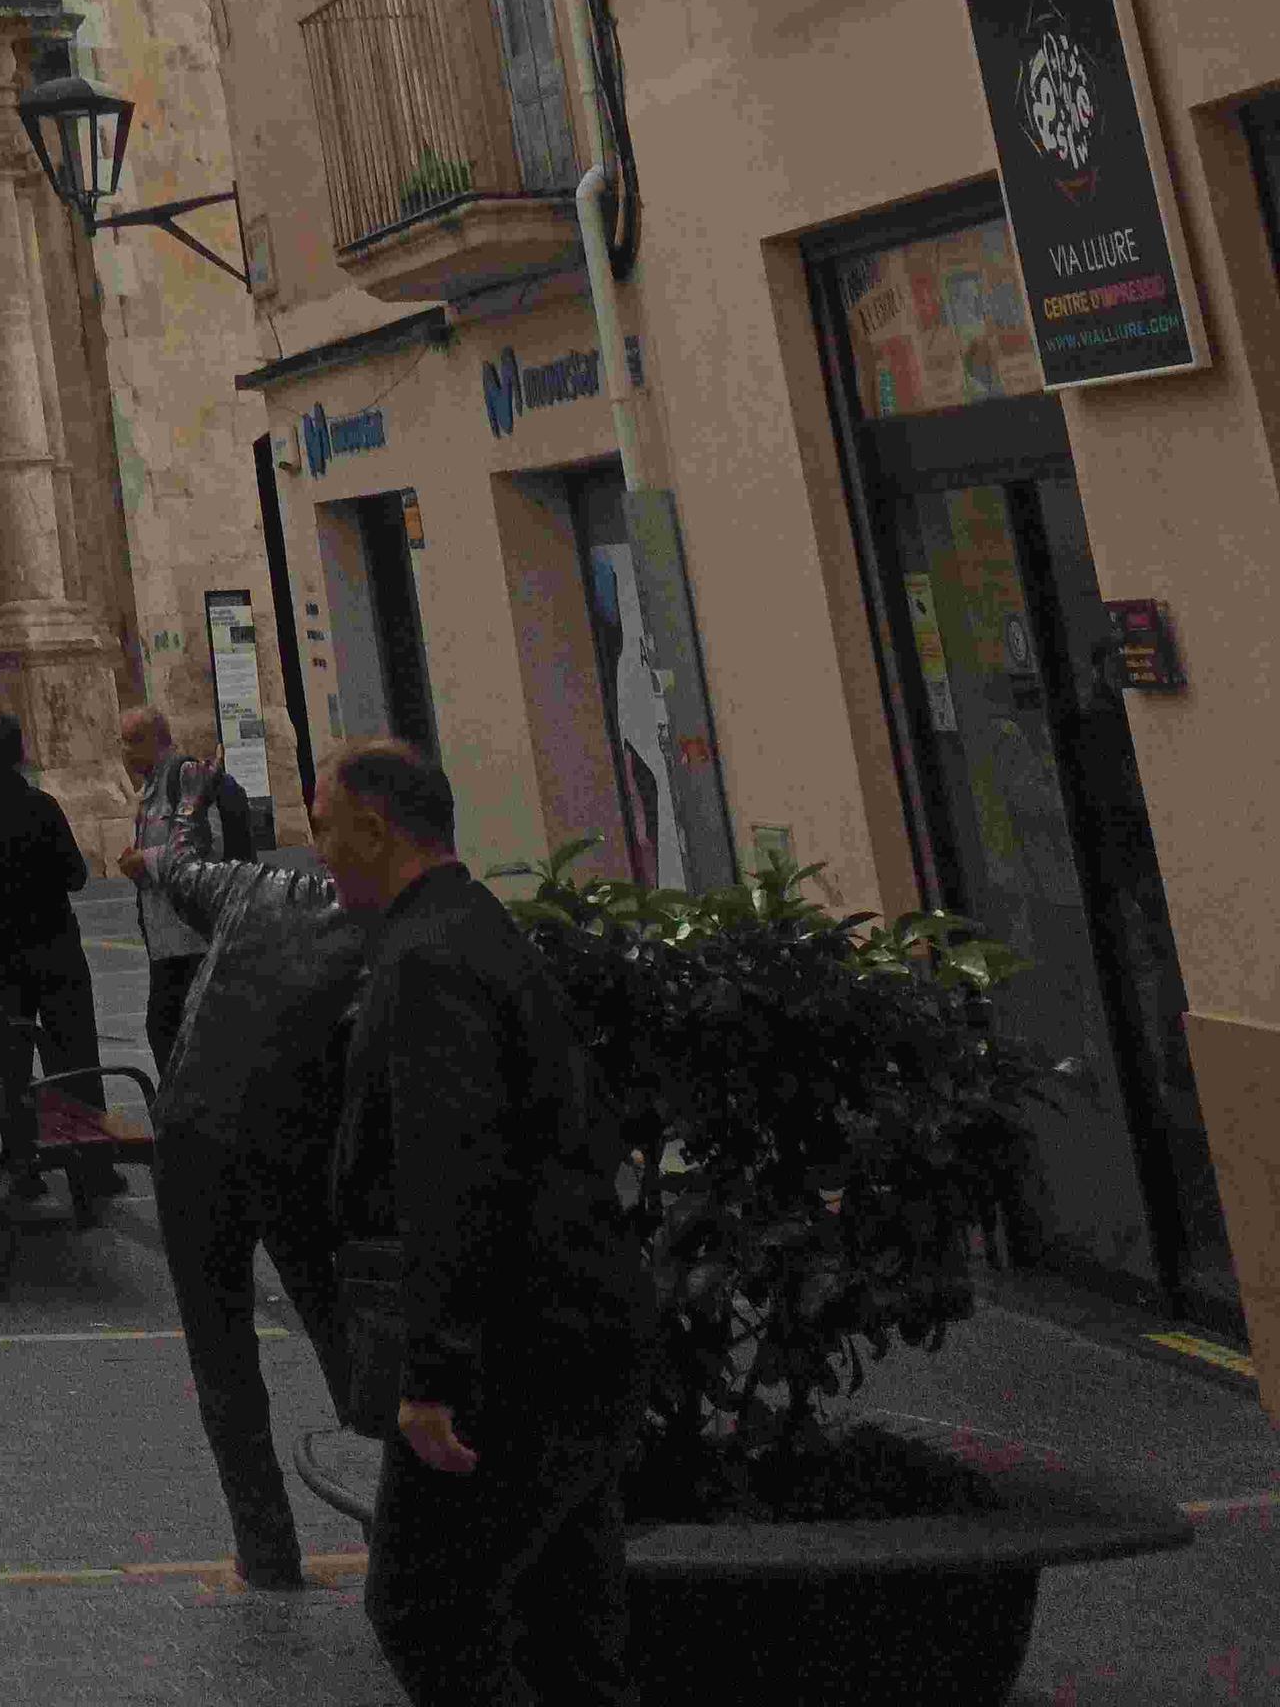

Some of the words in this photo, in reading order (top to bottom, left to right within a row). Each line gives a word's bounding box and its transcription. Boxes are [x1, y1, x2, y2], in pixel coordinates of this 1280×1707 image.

[1049, 243, 1083, 277] VIA
[1082, 228, 1140, 272] LLIURE
[1043, 290, 1090, 319] CENTRE
